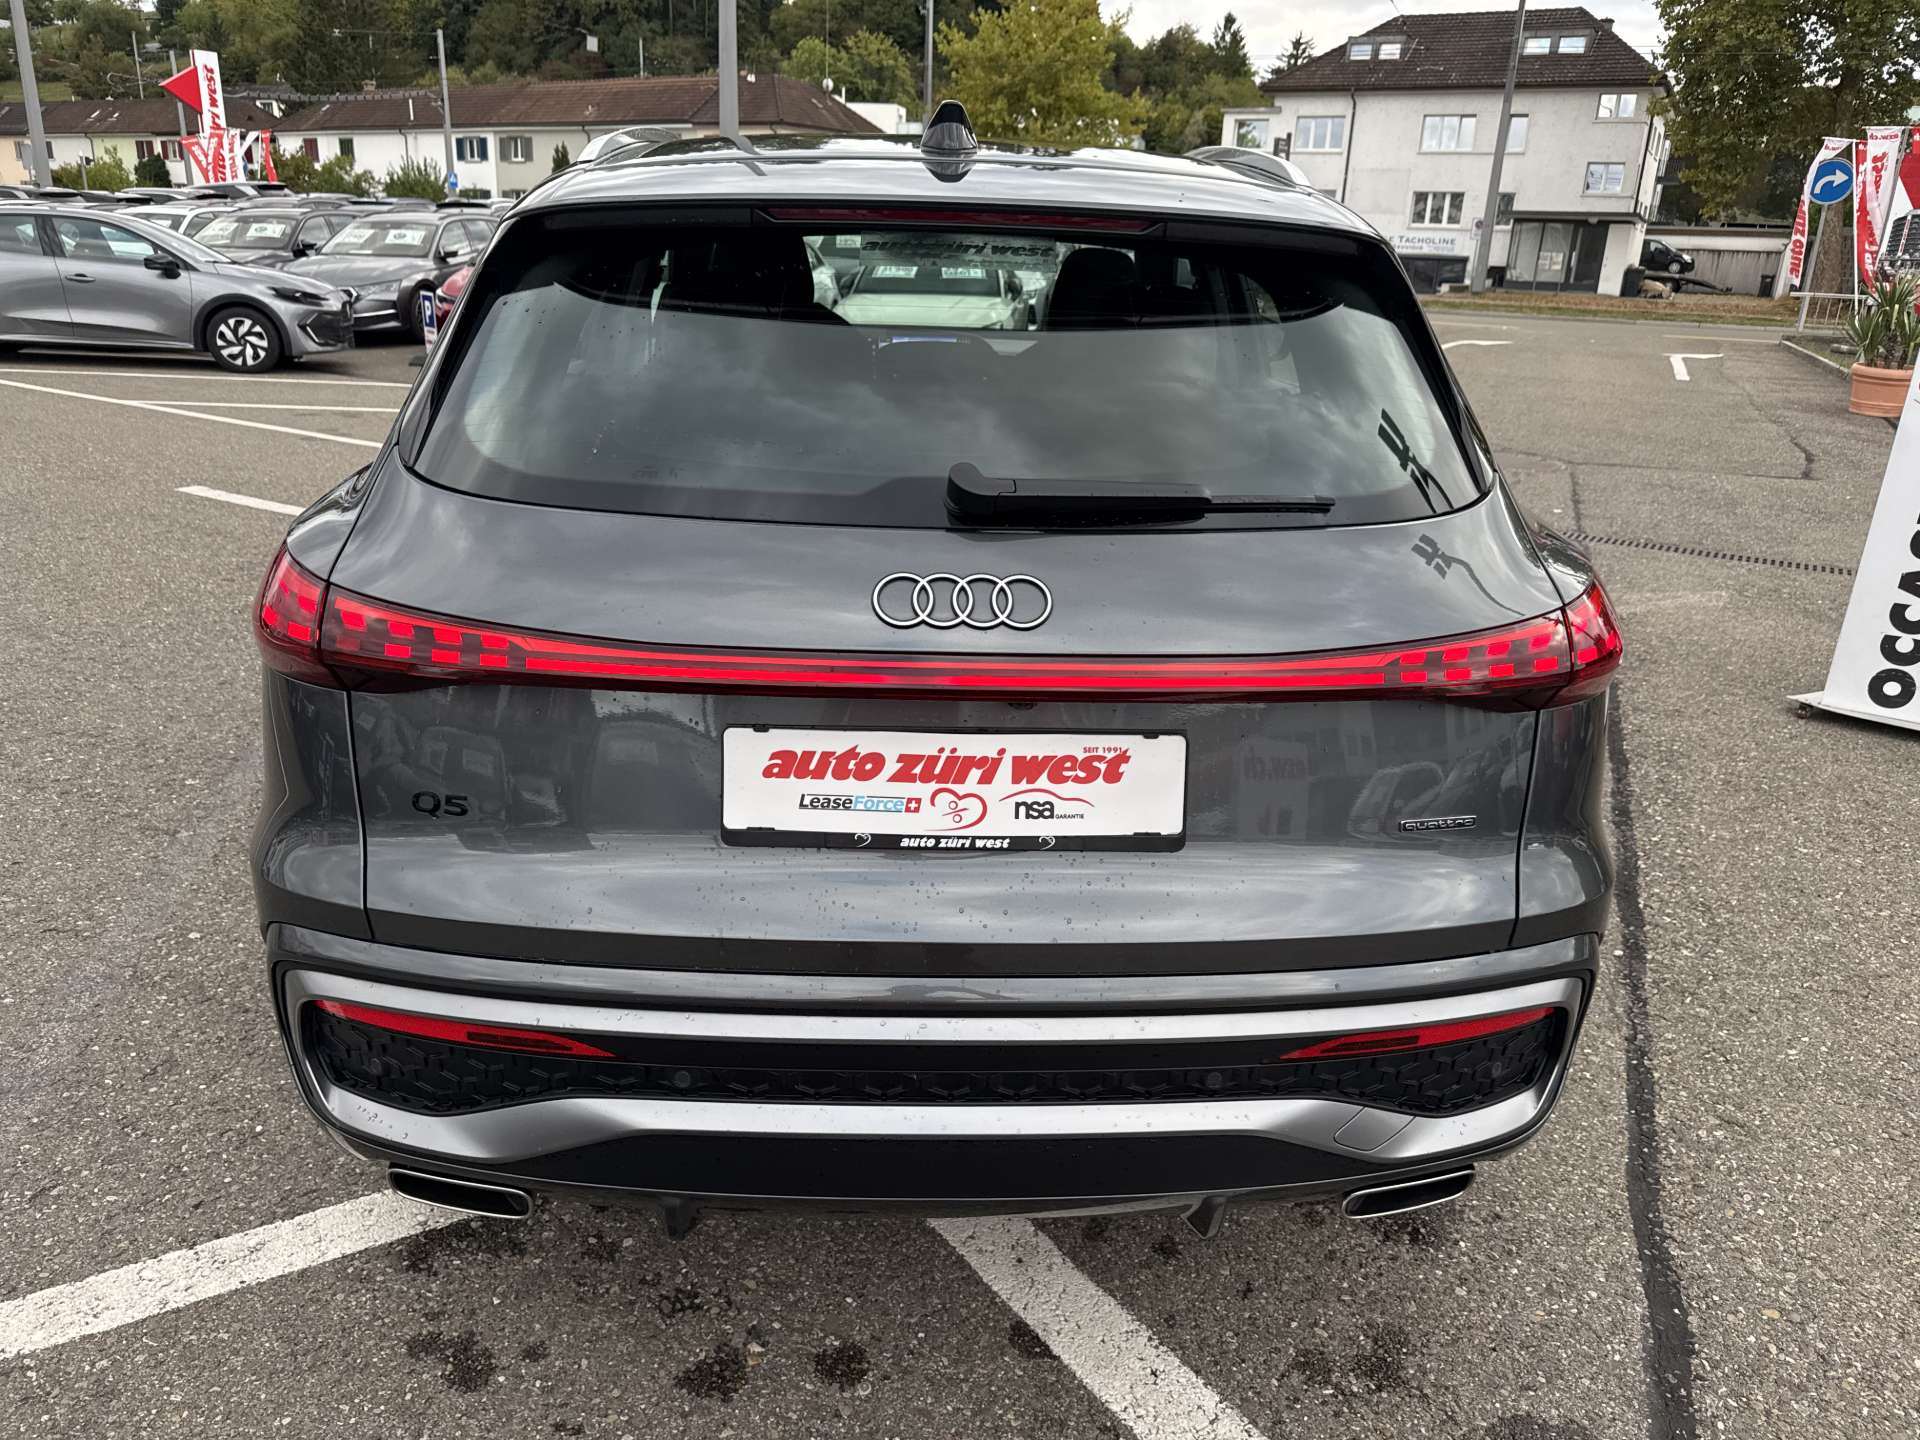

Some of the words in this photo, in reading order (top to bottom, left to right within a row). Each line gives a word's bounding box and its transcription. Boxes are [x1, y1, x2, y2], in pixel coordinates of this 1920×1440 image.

[202, 63, 219, 109] west
[1399, 235, 1456, 245] TACHOLINE
[1788, 239, 1804, 278] auto
[424, 300, 432, 324] P
[1083, 746, 1099, 754] SEIT
[1103, 746, 1123, 754] 1991
[762, 744, 886, 782] auto
[887, 747, 1007, 785] züri
[1011, 748, 1132, 785] west
[411, 790, 469, 819] Q5
[799, 793, 905, 813] LeaseForce
[1014, 800, 1055, 820] nsa
[1405, 818, 1475, 831] quattro
[900, 837, 936, 848] auto
[938, 837, 972, 848] züri
[975, 837, 1011, 849] west
